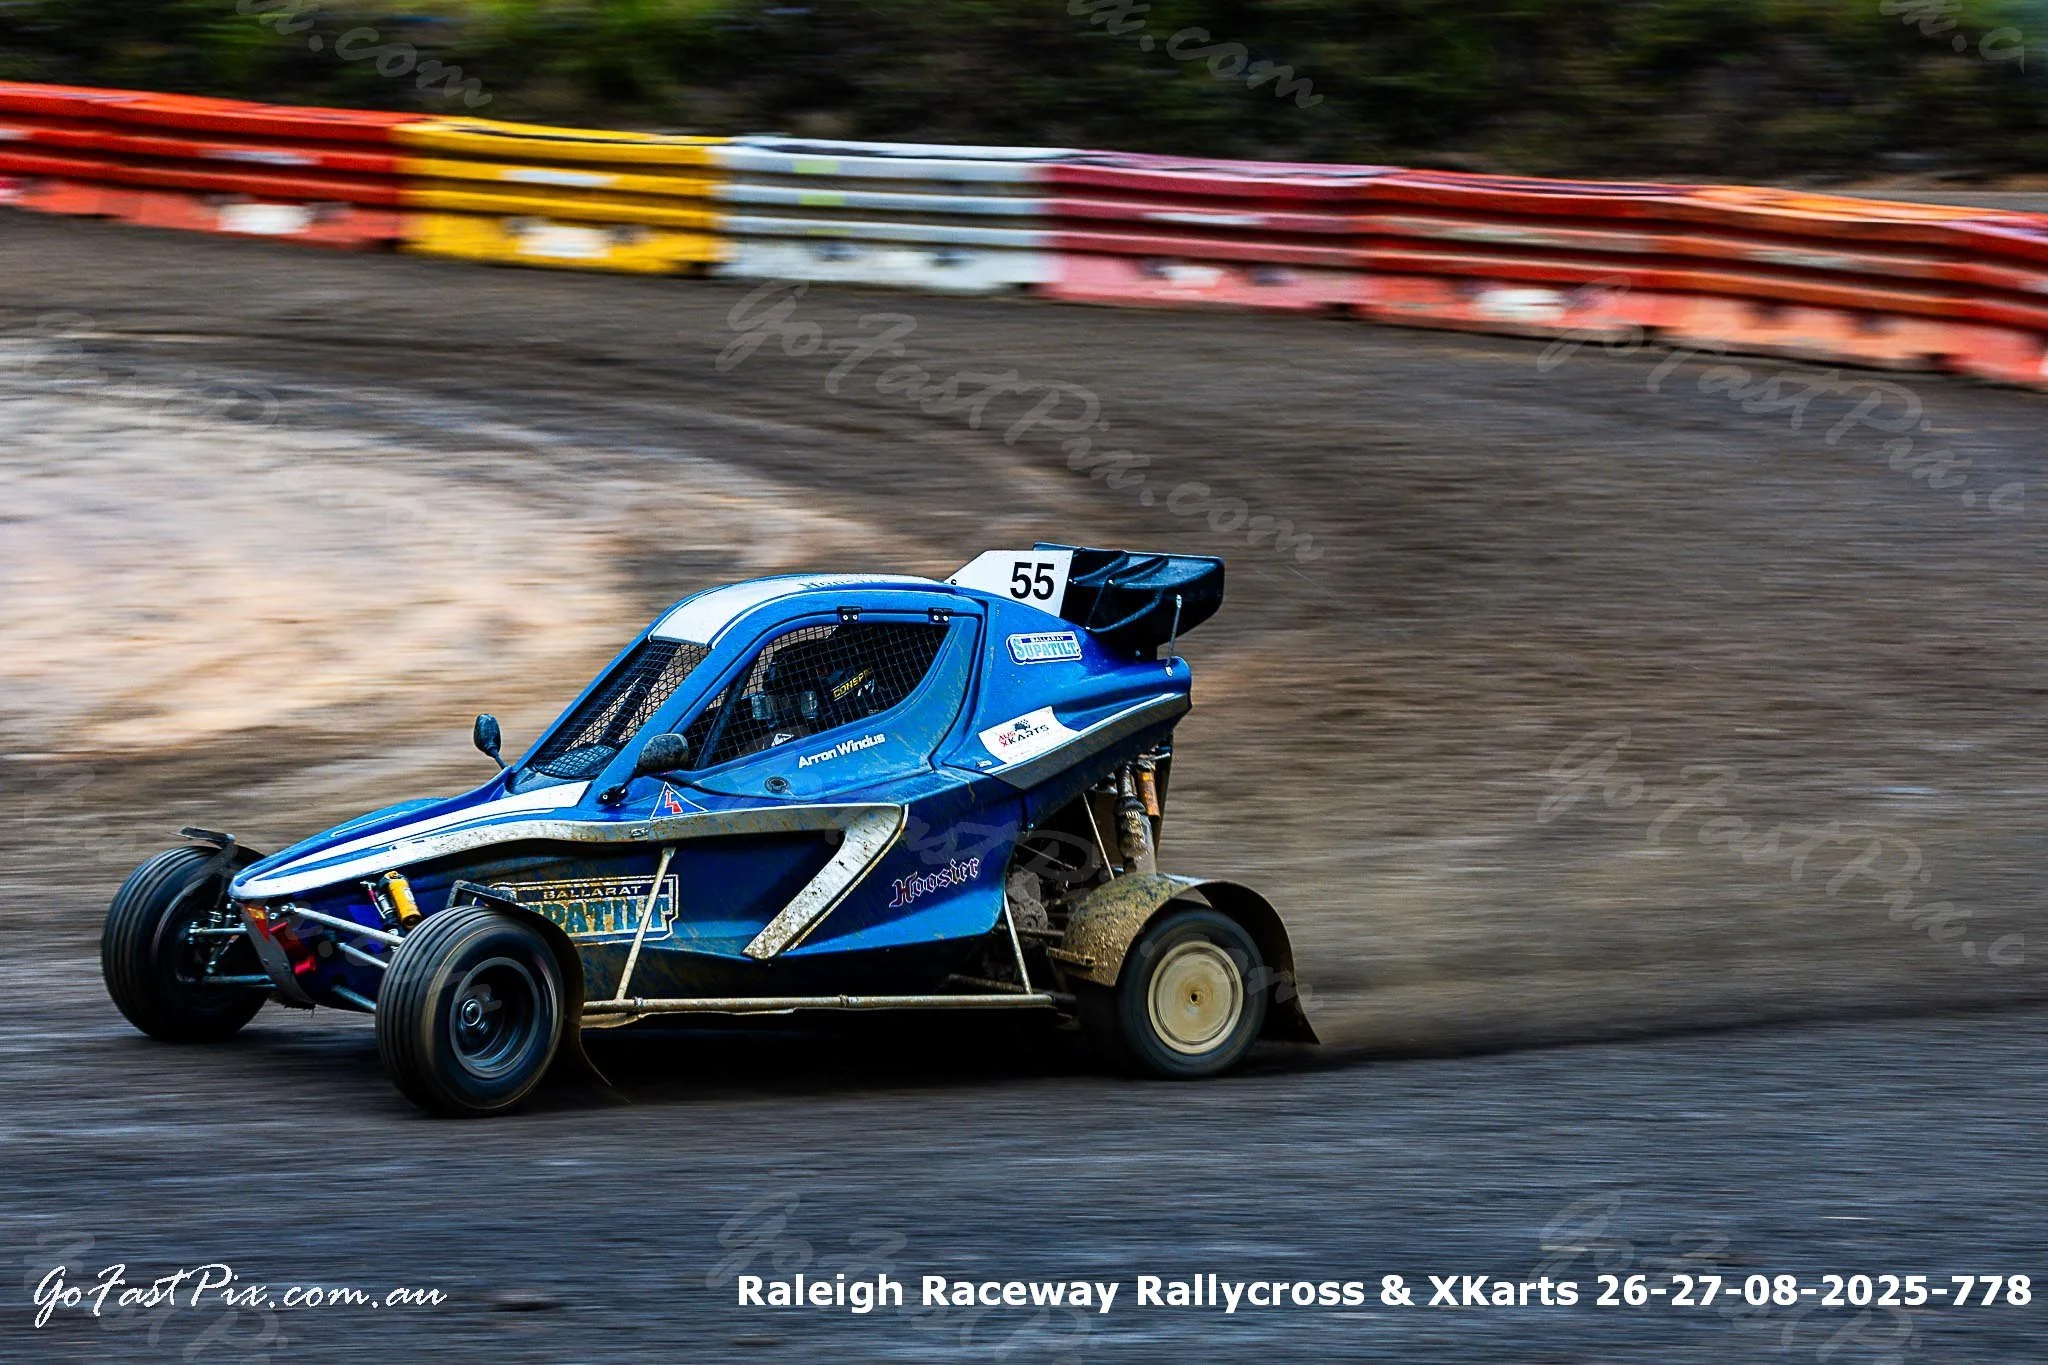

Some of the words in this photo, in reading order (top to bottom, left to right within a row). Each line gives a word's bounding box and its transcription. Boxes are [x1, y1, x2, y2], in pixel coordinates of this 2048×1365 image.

[1010, 562, 1055, 600] 55
[798, 749, 838, 769] Arron
[836, 732, 886, 756] Windus
[1001, 724, 1050, 748] XKARTS
[543, 885, 642, 900] BALLARAT
[888, 857, 980, 908] Hoosier
